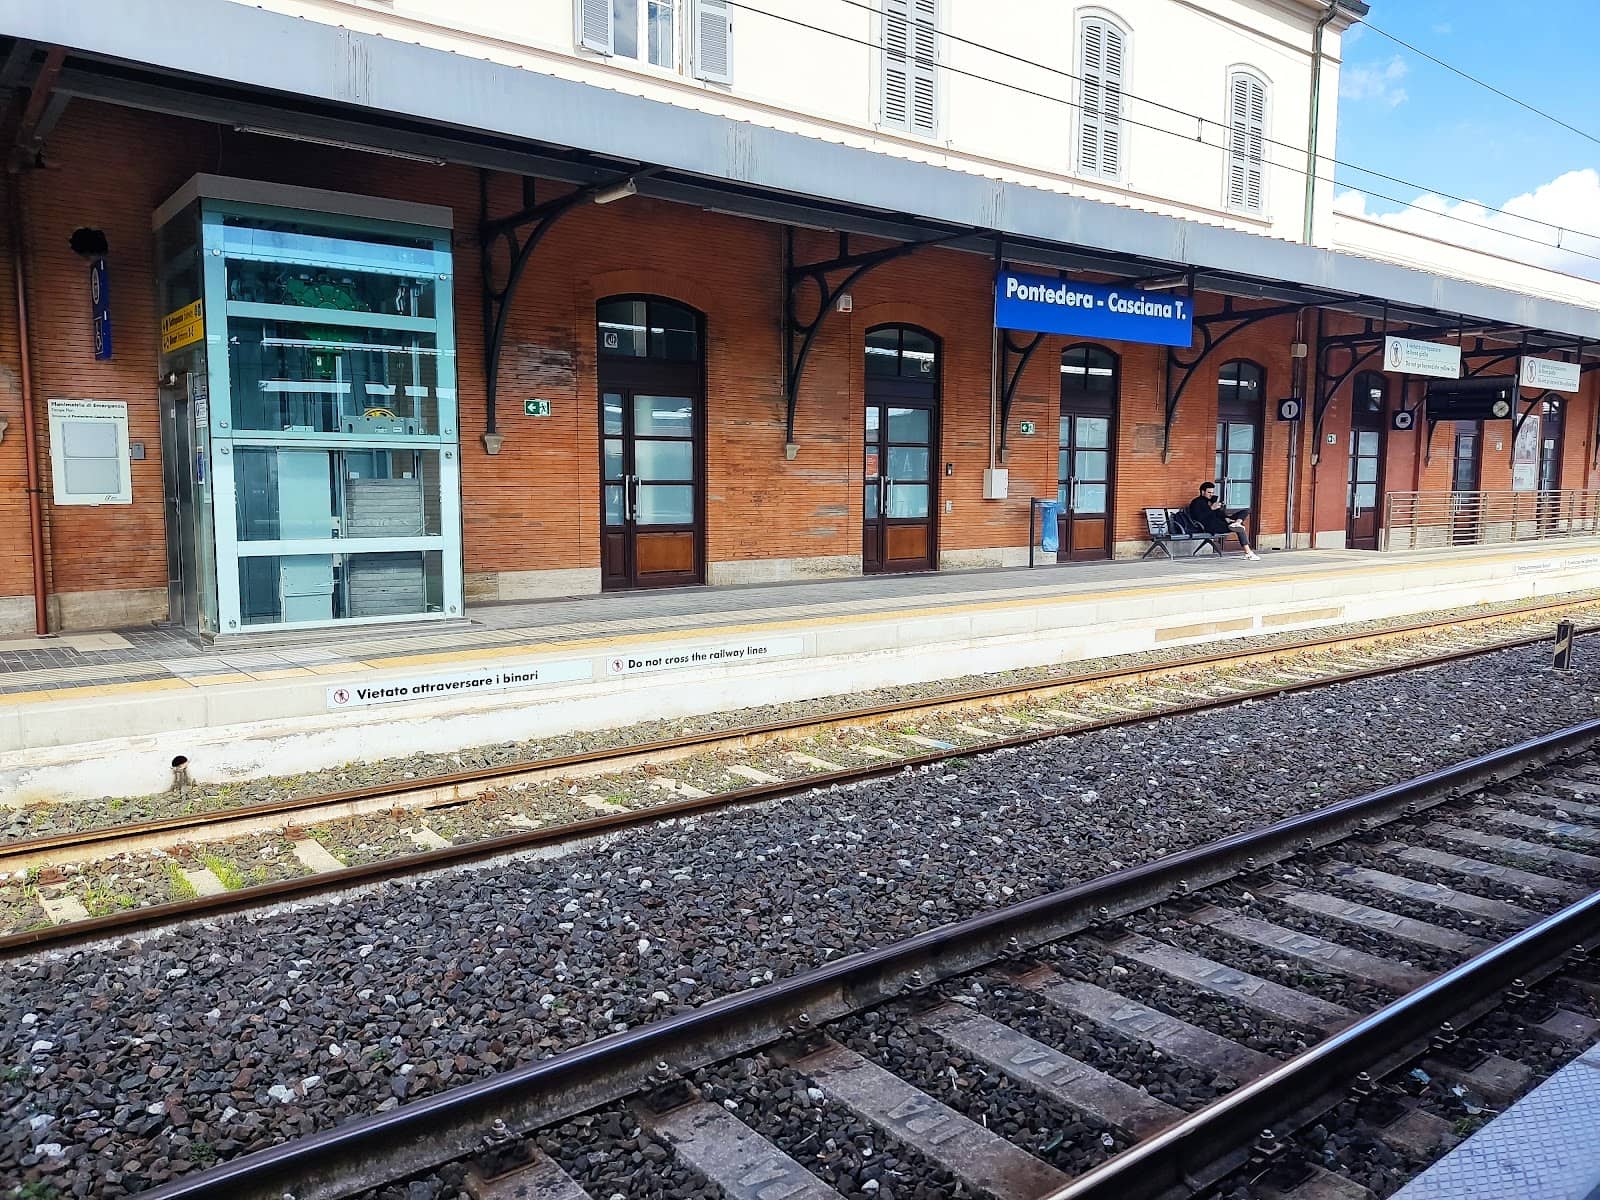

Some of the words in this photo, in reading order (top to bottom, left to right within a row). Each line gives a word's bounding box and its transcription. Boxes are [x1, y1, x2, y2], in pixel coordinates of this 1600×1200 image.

[1006, 277, 1093, 308] Pontedera
[1108, 292, 1171, 319] Casciana
[1175, 301, 1186, 320] T.
[1287, 404, 1292, 416] 1
[628, 659, 643, 669] Do
[645, 657, 662, 667] not
[665, 655, 689, 665] cross
[691, 652, 707, 662] the
[709, 649, 745, 660] railway
[747, 646, 768, 656] lines
[357, 687, 408, 700] Vietato
[412, 678, 493, 694] attraversare
[496, 674, 500, 684] i
[503, 670, 539, 684] binari
